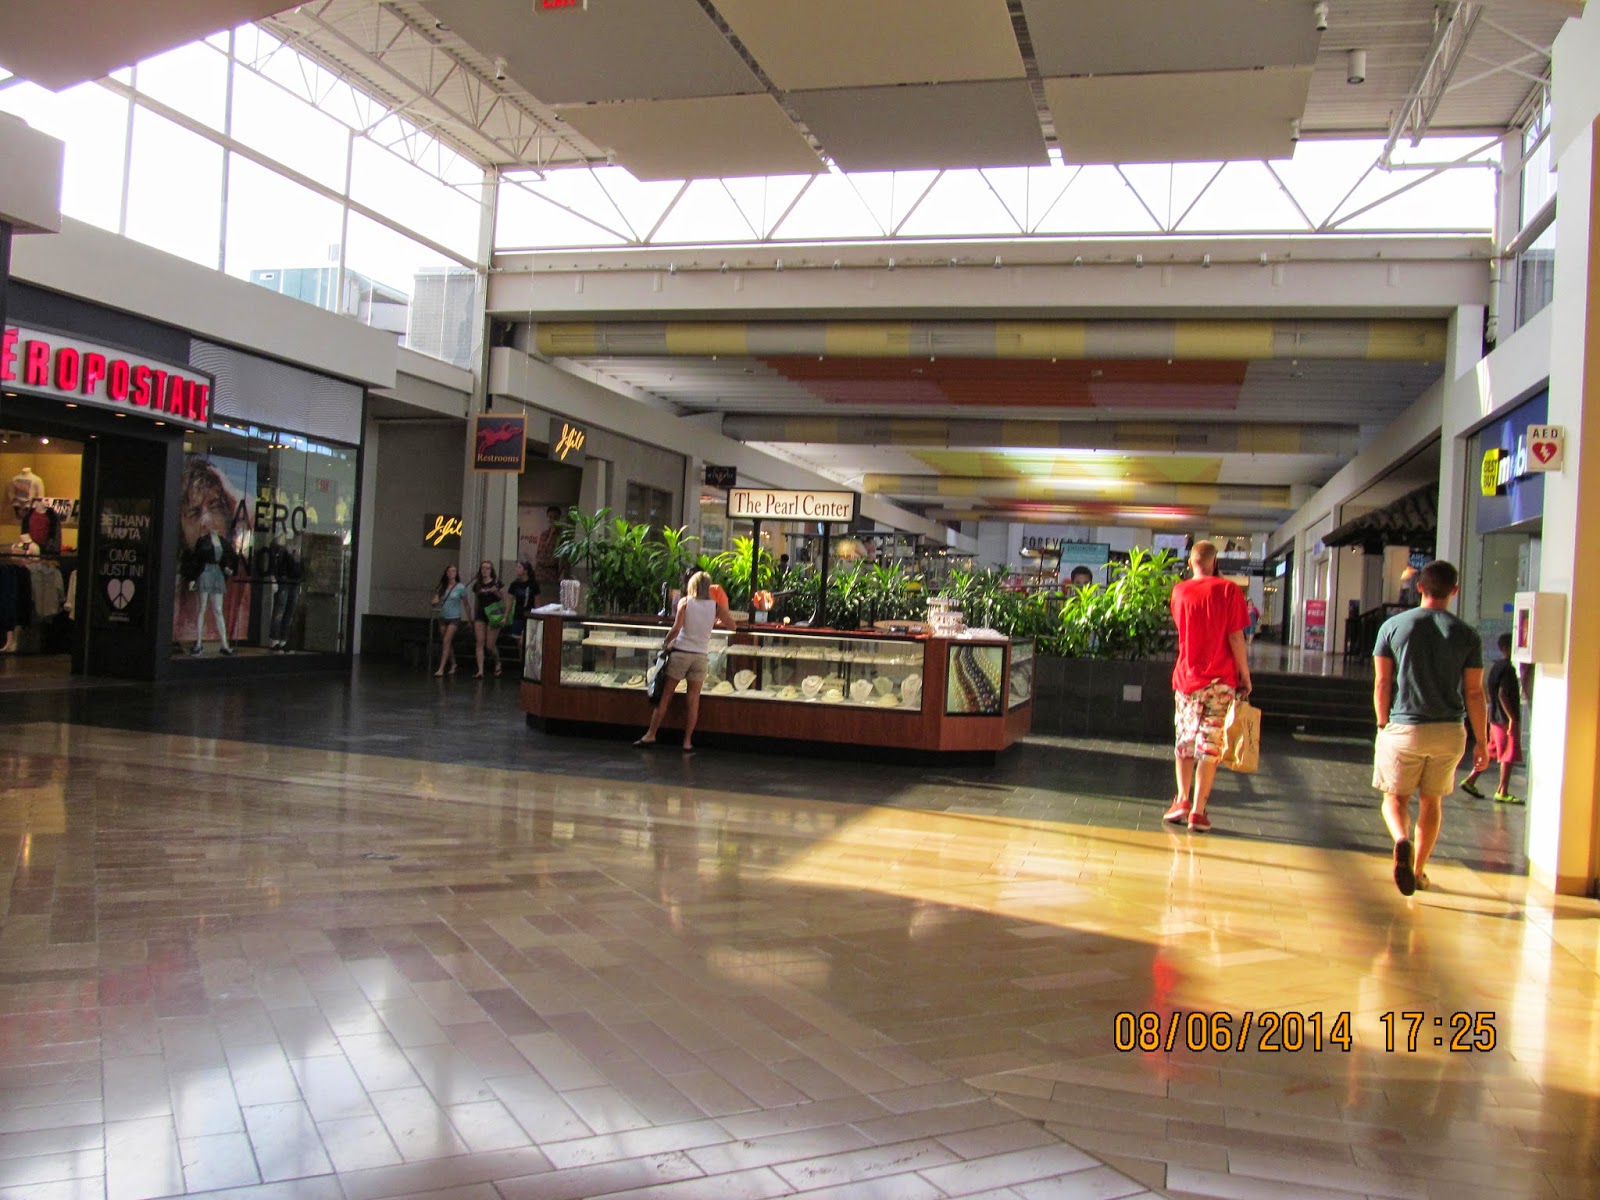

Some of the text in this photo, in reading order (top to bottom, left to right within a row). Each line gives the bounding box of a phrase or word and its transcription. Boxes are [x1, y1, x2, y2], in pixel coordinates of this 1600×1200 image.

[1532, 428, 1558, 439] AED
[477, 453, 519, 463] Restrooms
[1484, 460, 1497, 473] BEST
[1484, 474, 1496, 487] BUY
[734, 492, 850, 517] The Pearl Center
[231, 499, 307, 536] AERO
[109, 548, 137, 562] OMG
[101, 563, 144, 577] JUST IN!
